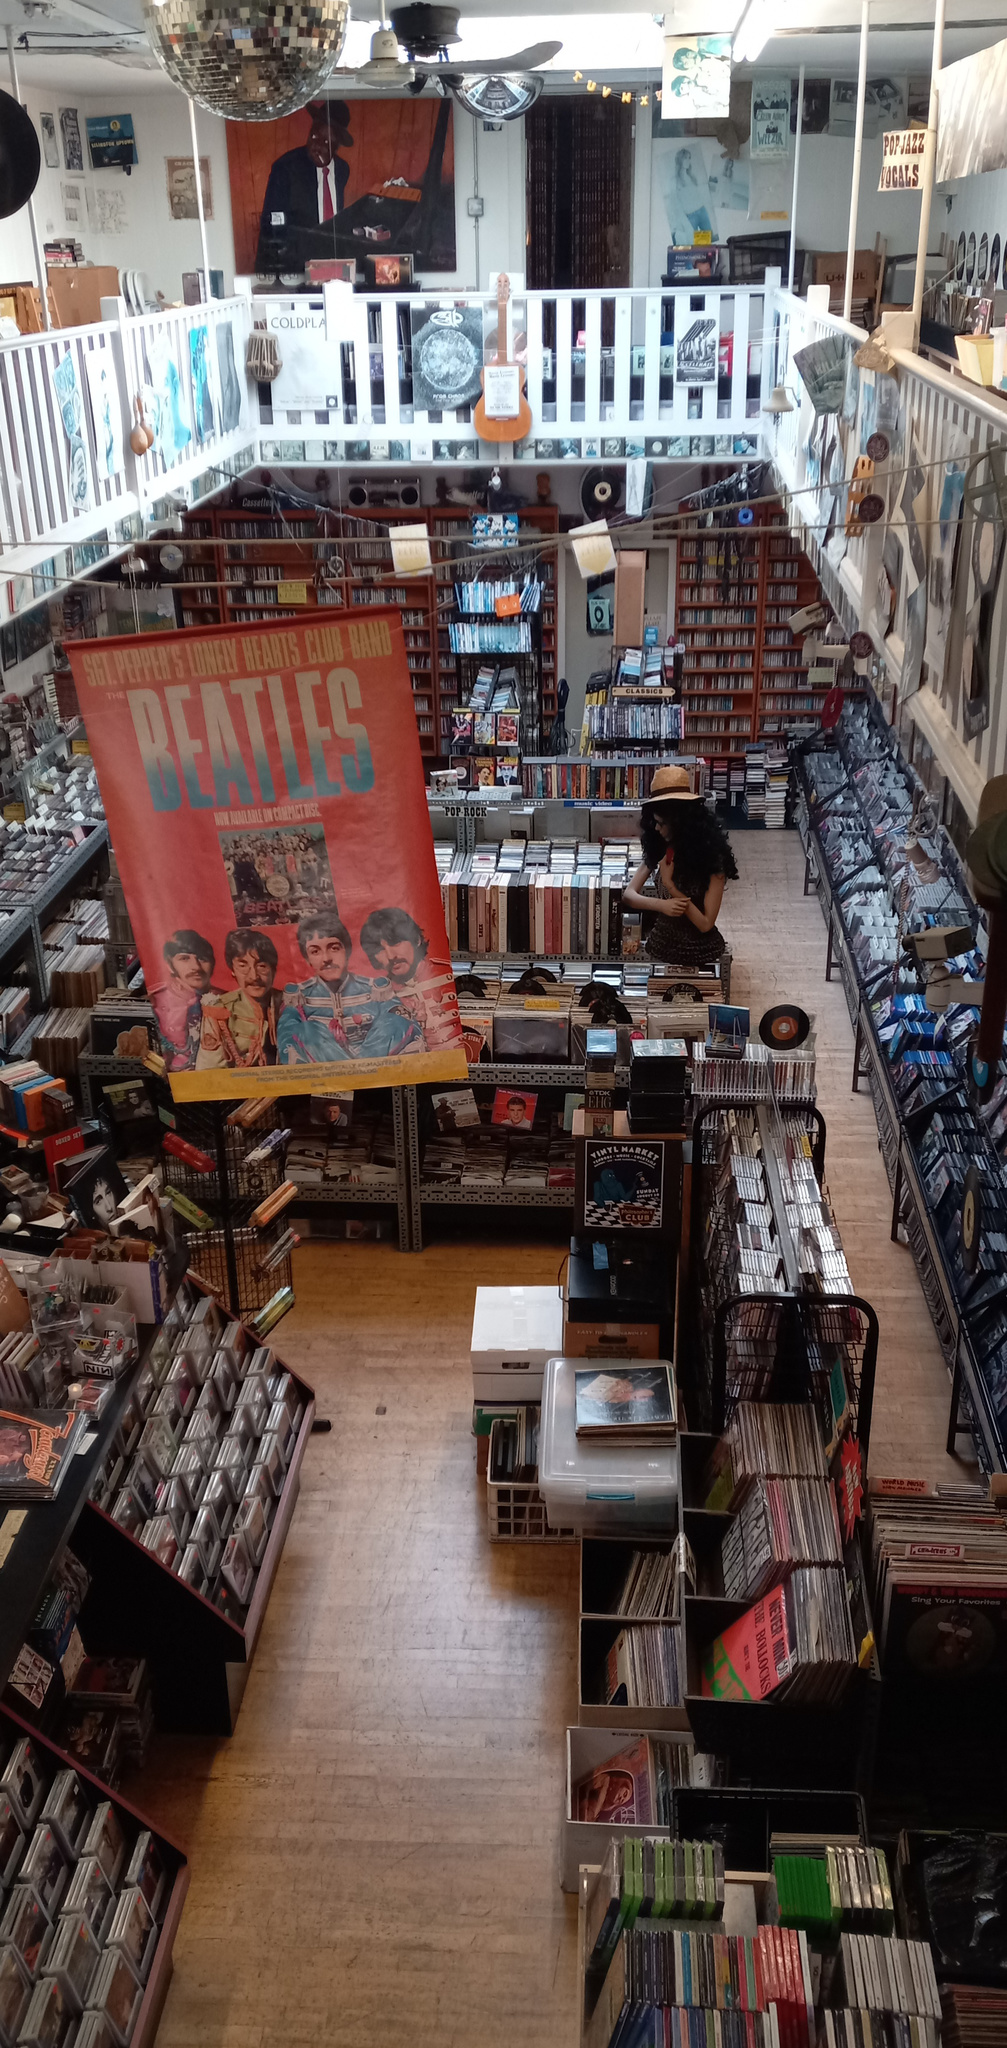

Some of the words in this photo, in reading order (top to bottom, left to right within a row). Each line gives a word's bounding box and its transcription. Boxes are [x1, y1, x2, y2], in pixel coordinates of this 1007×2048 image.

[883, 132, 925, 156] POP-JAZZ
[880, 164, 919, 188] VOCALS
[826, 272, 865, 282] U-HUL
[271, 317, 326, 329] COLDPLA
[82, 652, 117, 687] SGT.
[113, 644, 185, 684] PEPPER'S
[185, 638, 239, 677] LONELY
[241, 631, 300, 671] HEARTS
[304, 626, 344, 664] CLUB
[348, 621, 392, 659] BAND
[106, 691, 125, 700] THE
[126, 667, 375, 812] BEATLES
[214, 811, 229, 826] NOW
[230, 808, 263, 825] AVAILABLE
[263, 808, 273, 822] ON
[273, 804, 305, 821] COMPACT
[445, 807, 487, 817] POP-ROCK
[72, 1131, 81, 1140] SET
[590, 1146, 619, 1159] VINYL
[621, 1146, 659, 1161] MARKET
[911, 1596, 932, 1605] Sing
[754, 1600, 765, 1629] THE
[769, 1597, 783, 1638] NEVER
[756, 1628, 771, 1695] BOLLOCKS
